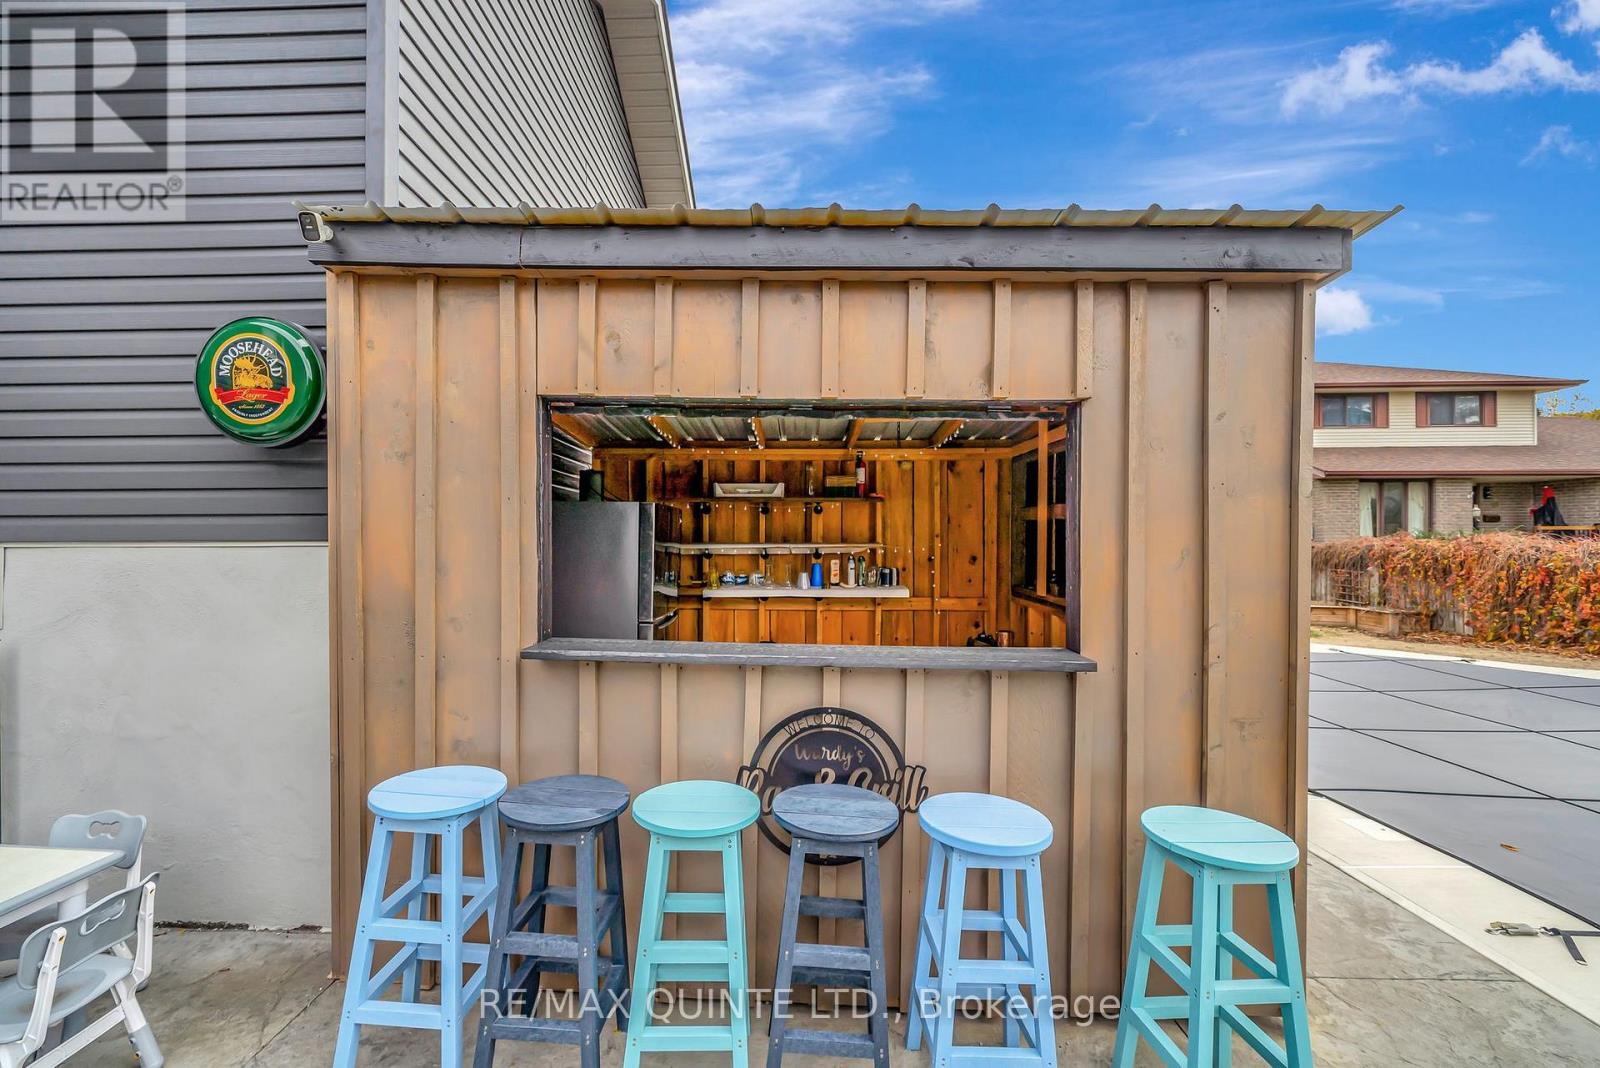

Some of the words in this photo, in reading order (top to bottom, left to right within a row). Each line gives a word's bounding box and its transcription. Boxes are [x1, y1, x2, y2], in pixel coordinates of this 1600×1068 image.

[218, 341, 283, 377] MOOSEHEAD
[233, 388, 268, 403] Lager
[783, 713, 856, 737] WELCOME
